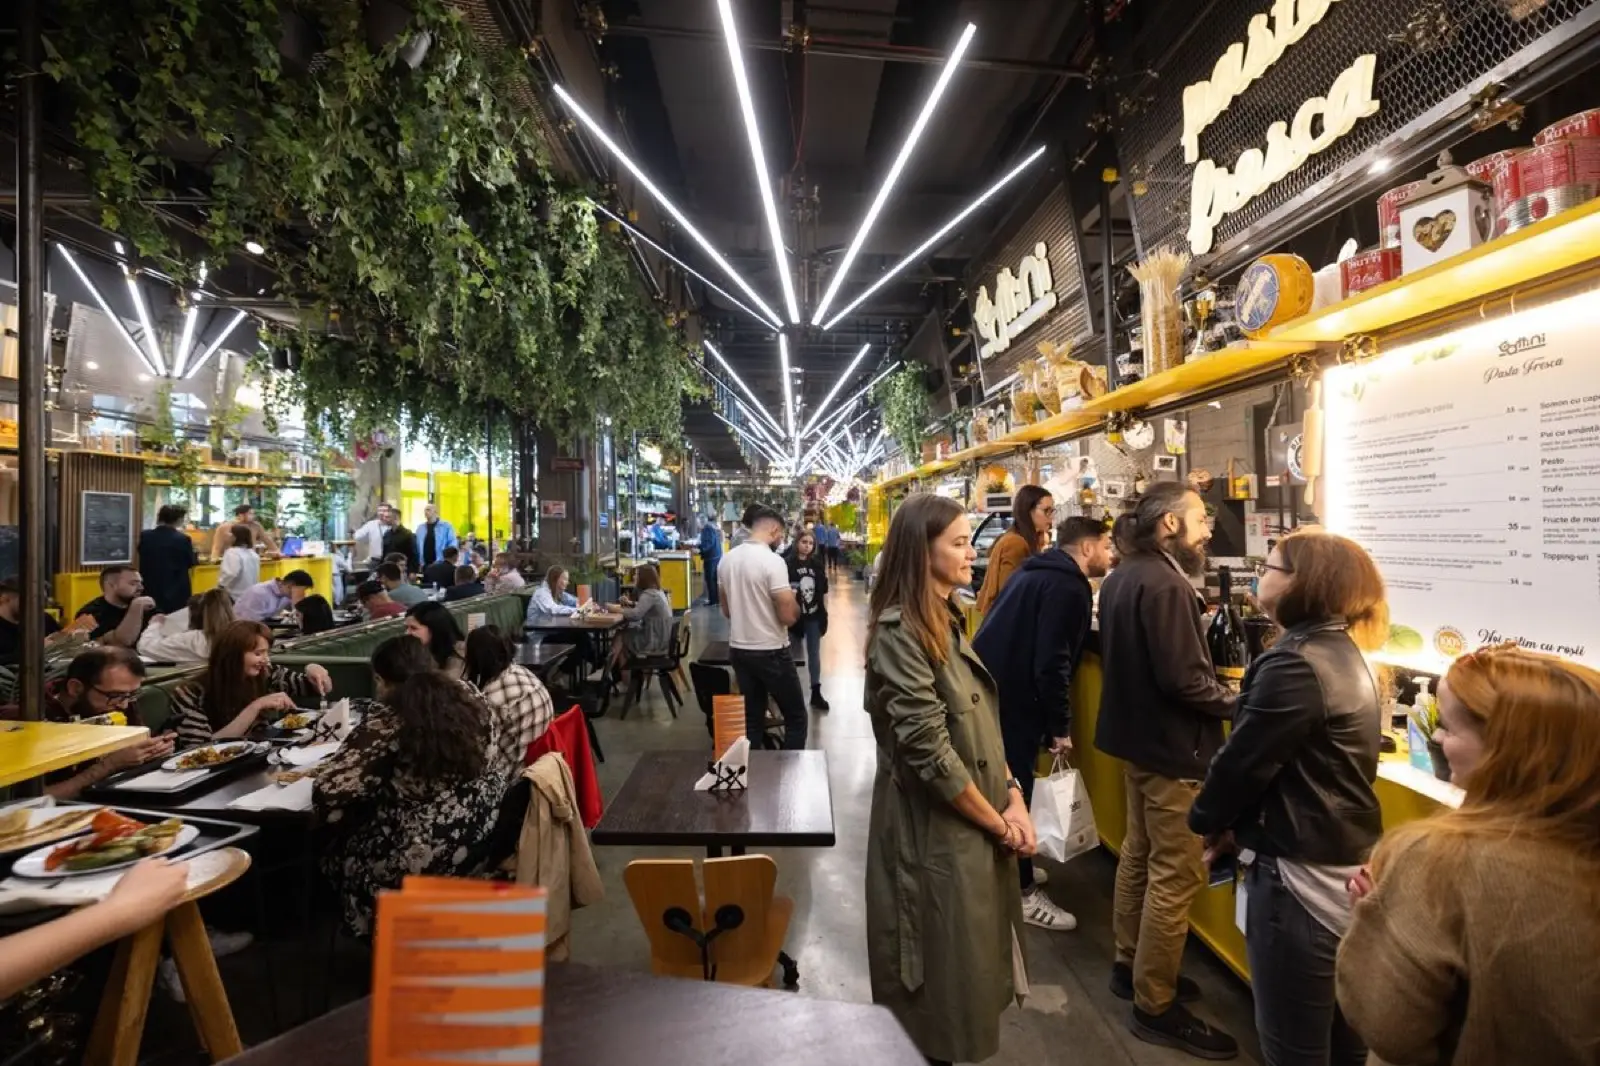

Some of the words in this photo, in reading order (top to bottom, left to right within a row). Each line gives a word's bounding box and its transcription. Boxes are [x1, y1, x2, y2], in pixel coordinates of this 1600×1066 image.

[1483, 365, 1519, 384] Pasta
[1522, 356, 1564, 377] Fresca
[1542, 485, 1564, 493] Trufe
[1540, 642, 1554, 651] cu
